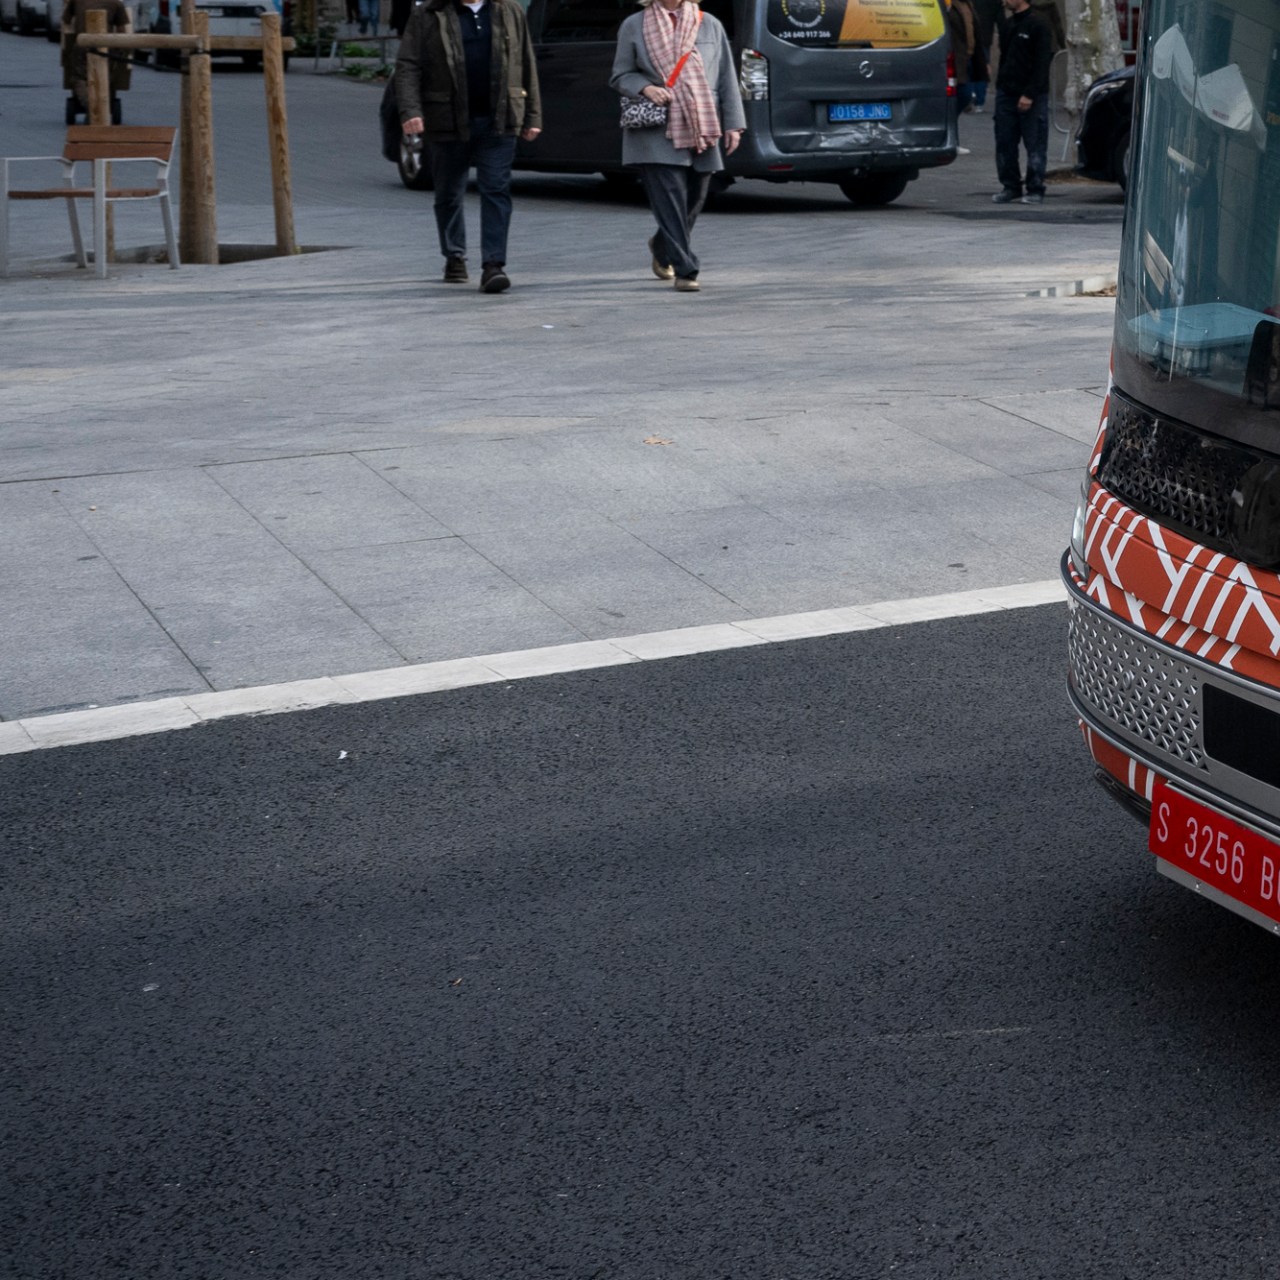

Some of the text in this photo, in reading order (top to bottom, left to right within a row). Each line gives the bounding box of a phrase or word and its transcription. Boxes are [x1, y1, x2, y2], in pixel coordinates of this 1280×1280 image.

[836, 104, 888, 118] 0158 JNG
[1156, 801, 1171, 844] S
[1184, 816, 1246, 885] 3256
